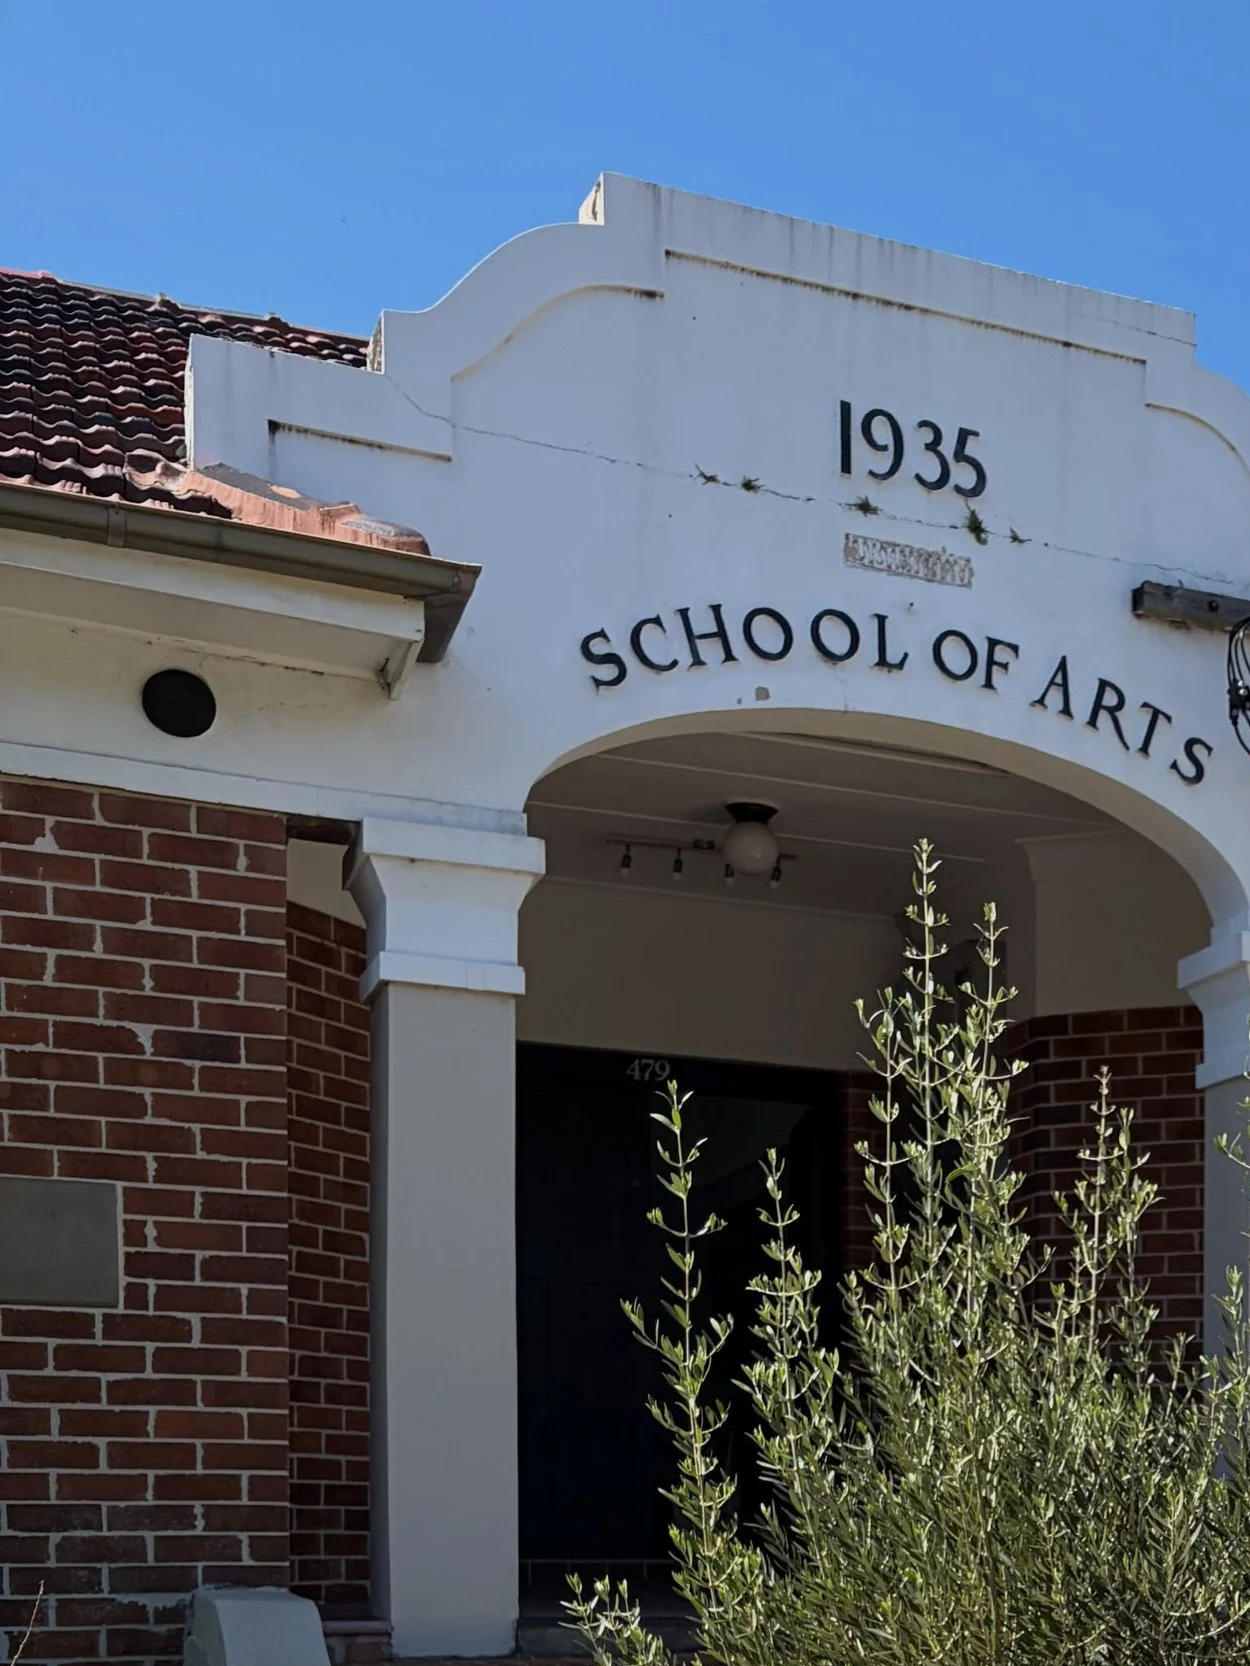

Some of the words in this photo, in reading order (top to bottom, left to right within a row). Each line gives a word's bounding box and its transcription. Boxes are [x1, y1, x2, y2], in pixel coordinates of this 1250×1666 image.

[838, 400, 988, 499] 1935
[580, 603, 909, 690] SCHOOL
[932, 628, 1020, 690] OF
[1029, 655, 1214, 786] ARTS
[626, 1058, 671, 1081] 479
